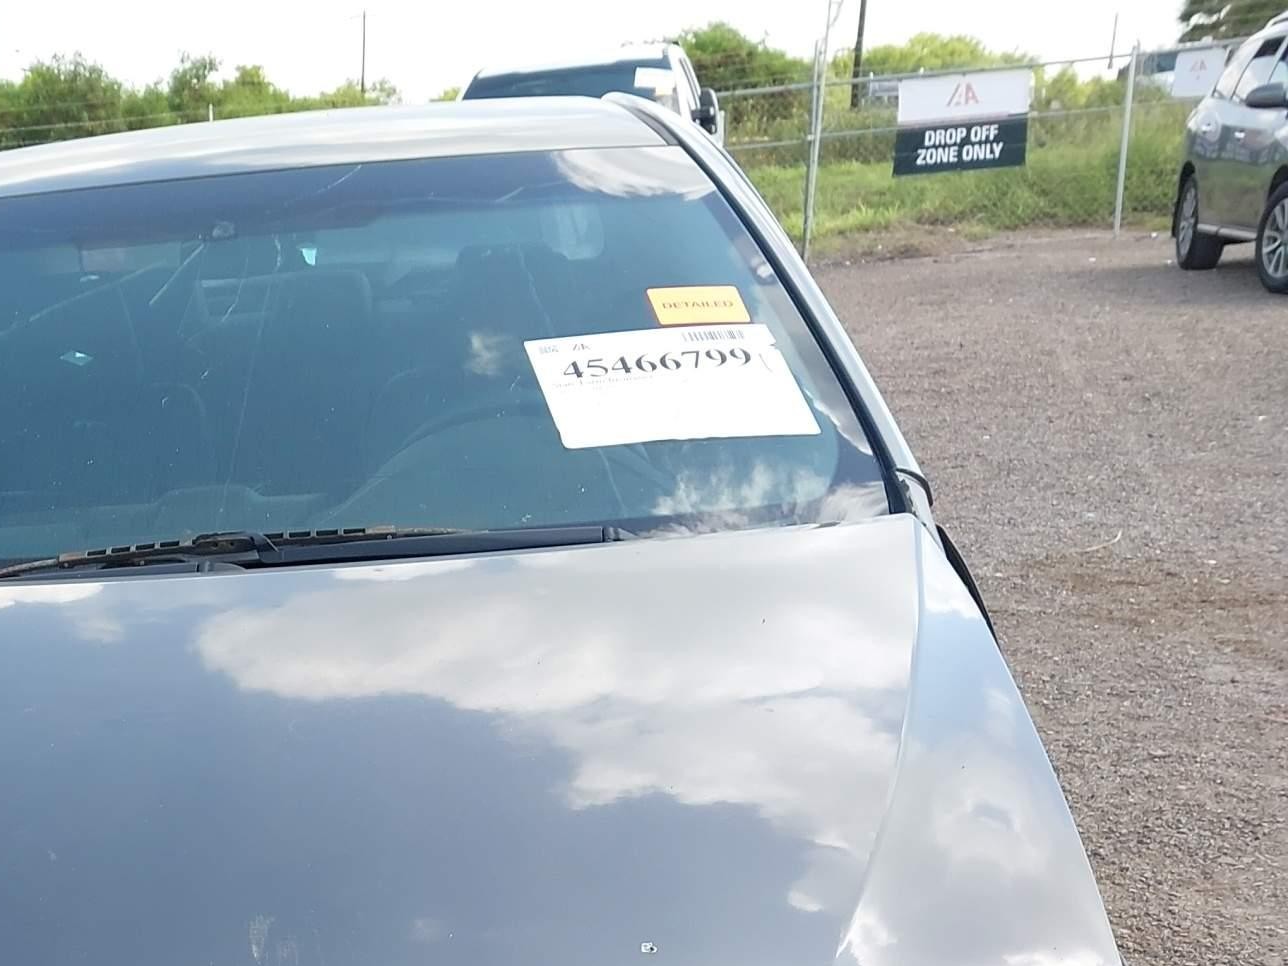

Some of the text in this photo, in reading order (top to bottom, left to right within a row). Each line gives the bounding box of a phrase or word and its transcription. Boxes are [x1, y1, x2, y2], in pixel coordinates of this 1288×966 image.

[924, 124, 999, 146] DROP OFF
[915, 142, 1004, 165] ZONE ONLY
[661, 300, 734, 309] DETAILED
[562, 347, 752, 378] 45466799
